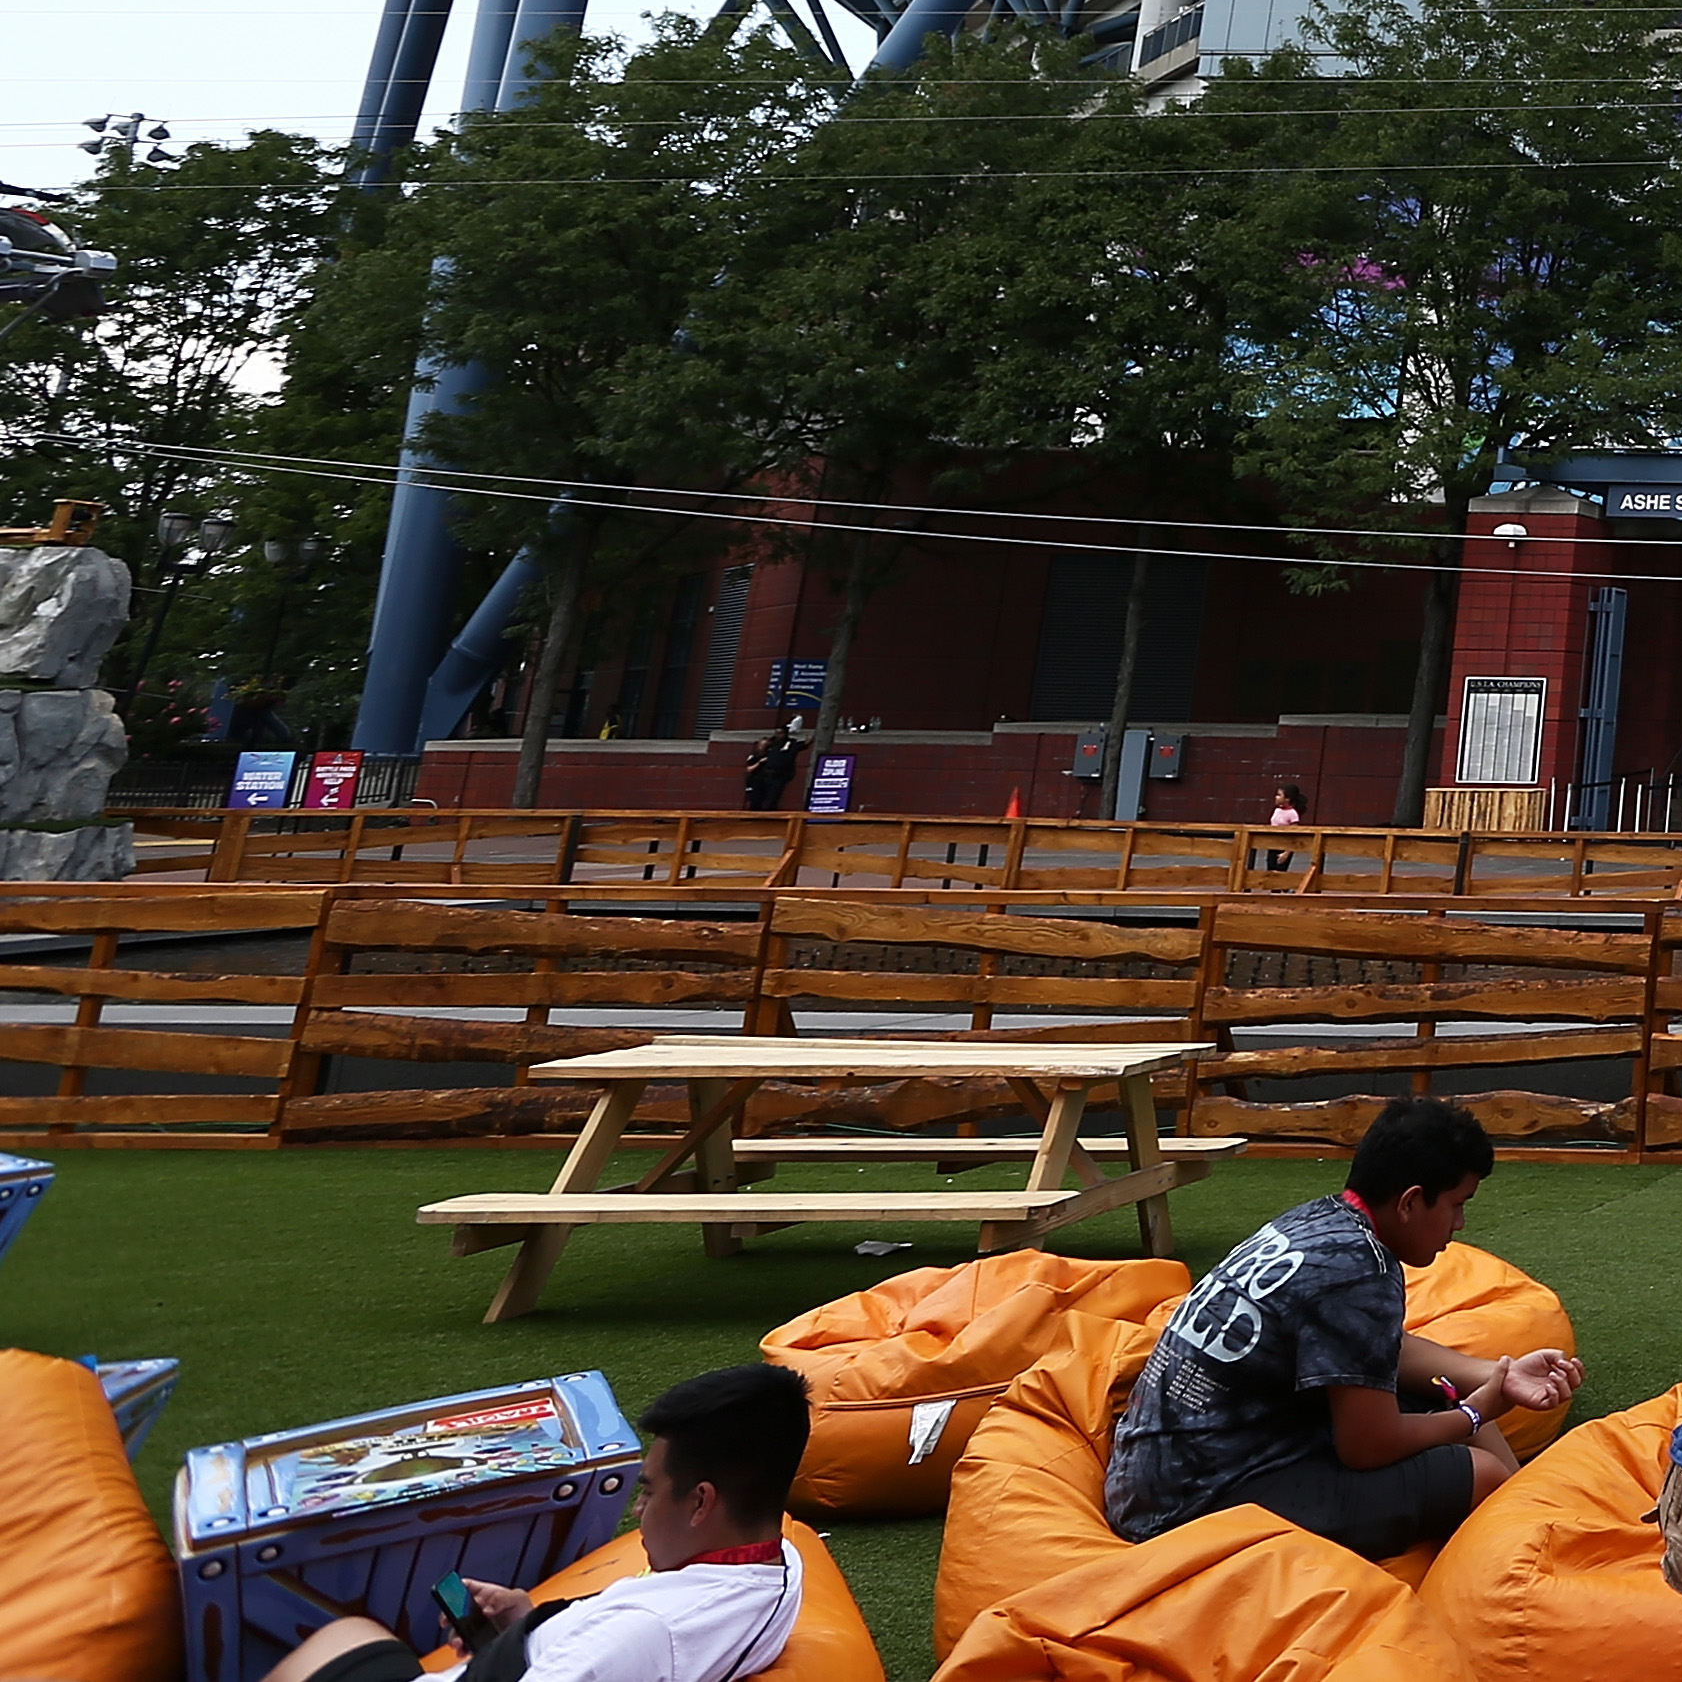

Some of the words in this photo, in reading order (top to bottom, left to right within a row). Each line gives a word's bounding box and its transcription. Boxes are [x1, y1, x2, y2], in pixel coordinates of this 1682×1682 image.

[1620, 495, 1671, 510] ASHE
[242, 771, 283, 780] WATER
[235, 780, 286, 791] STATION
